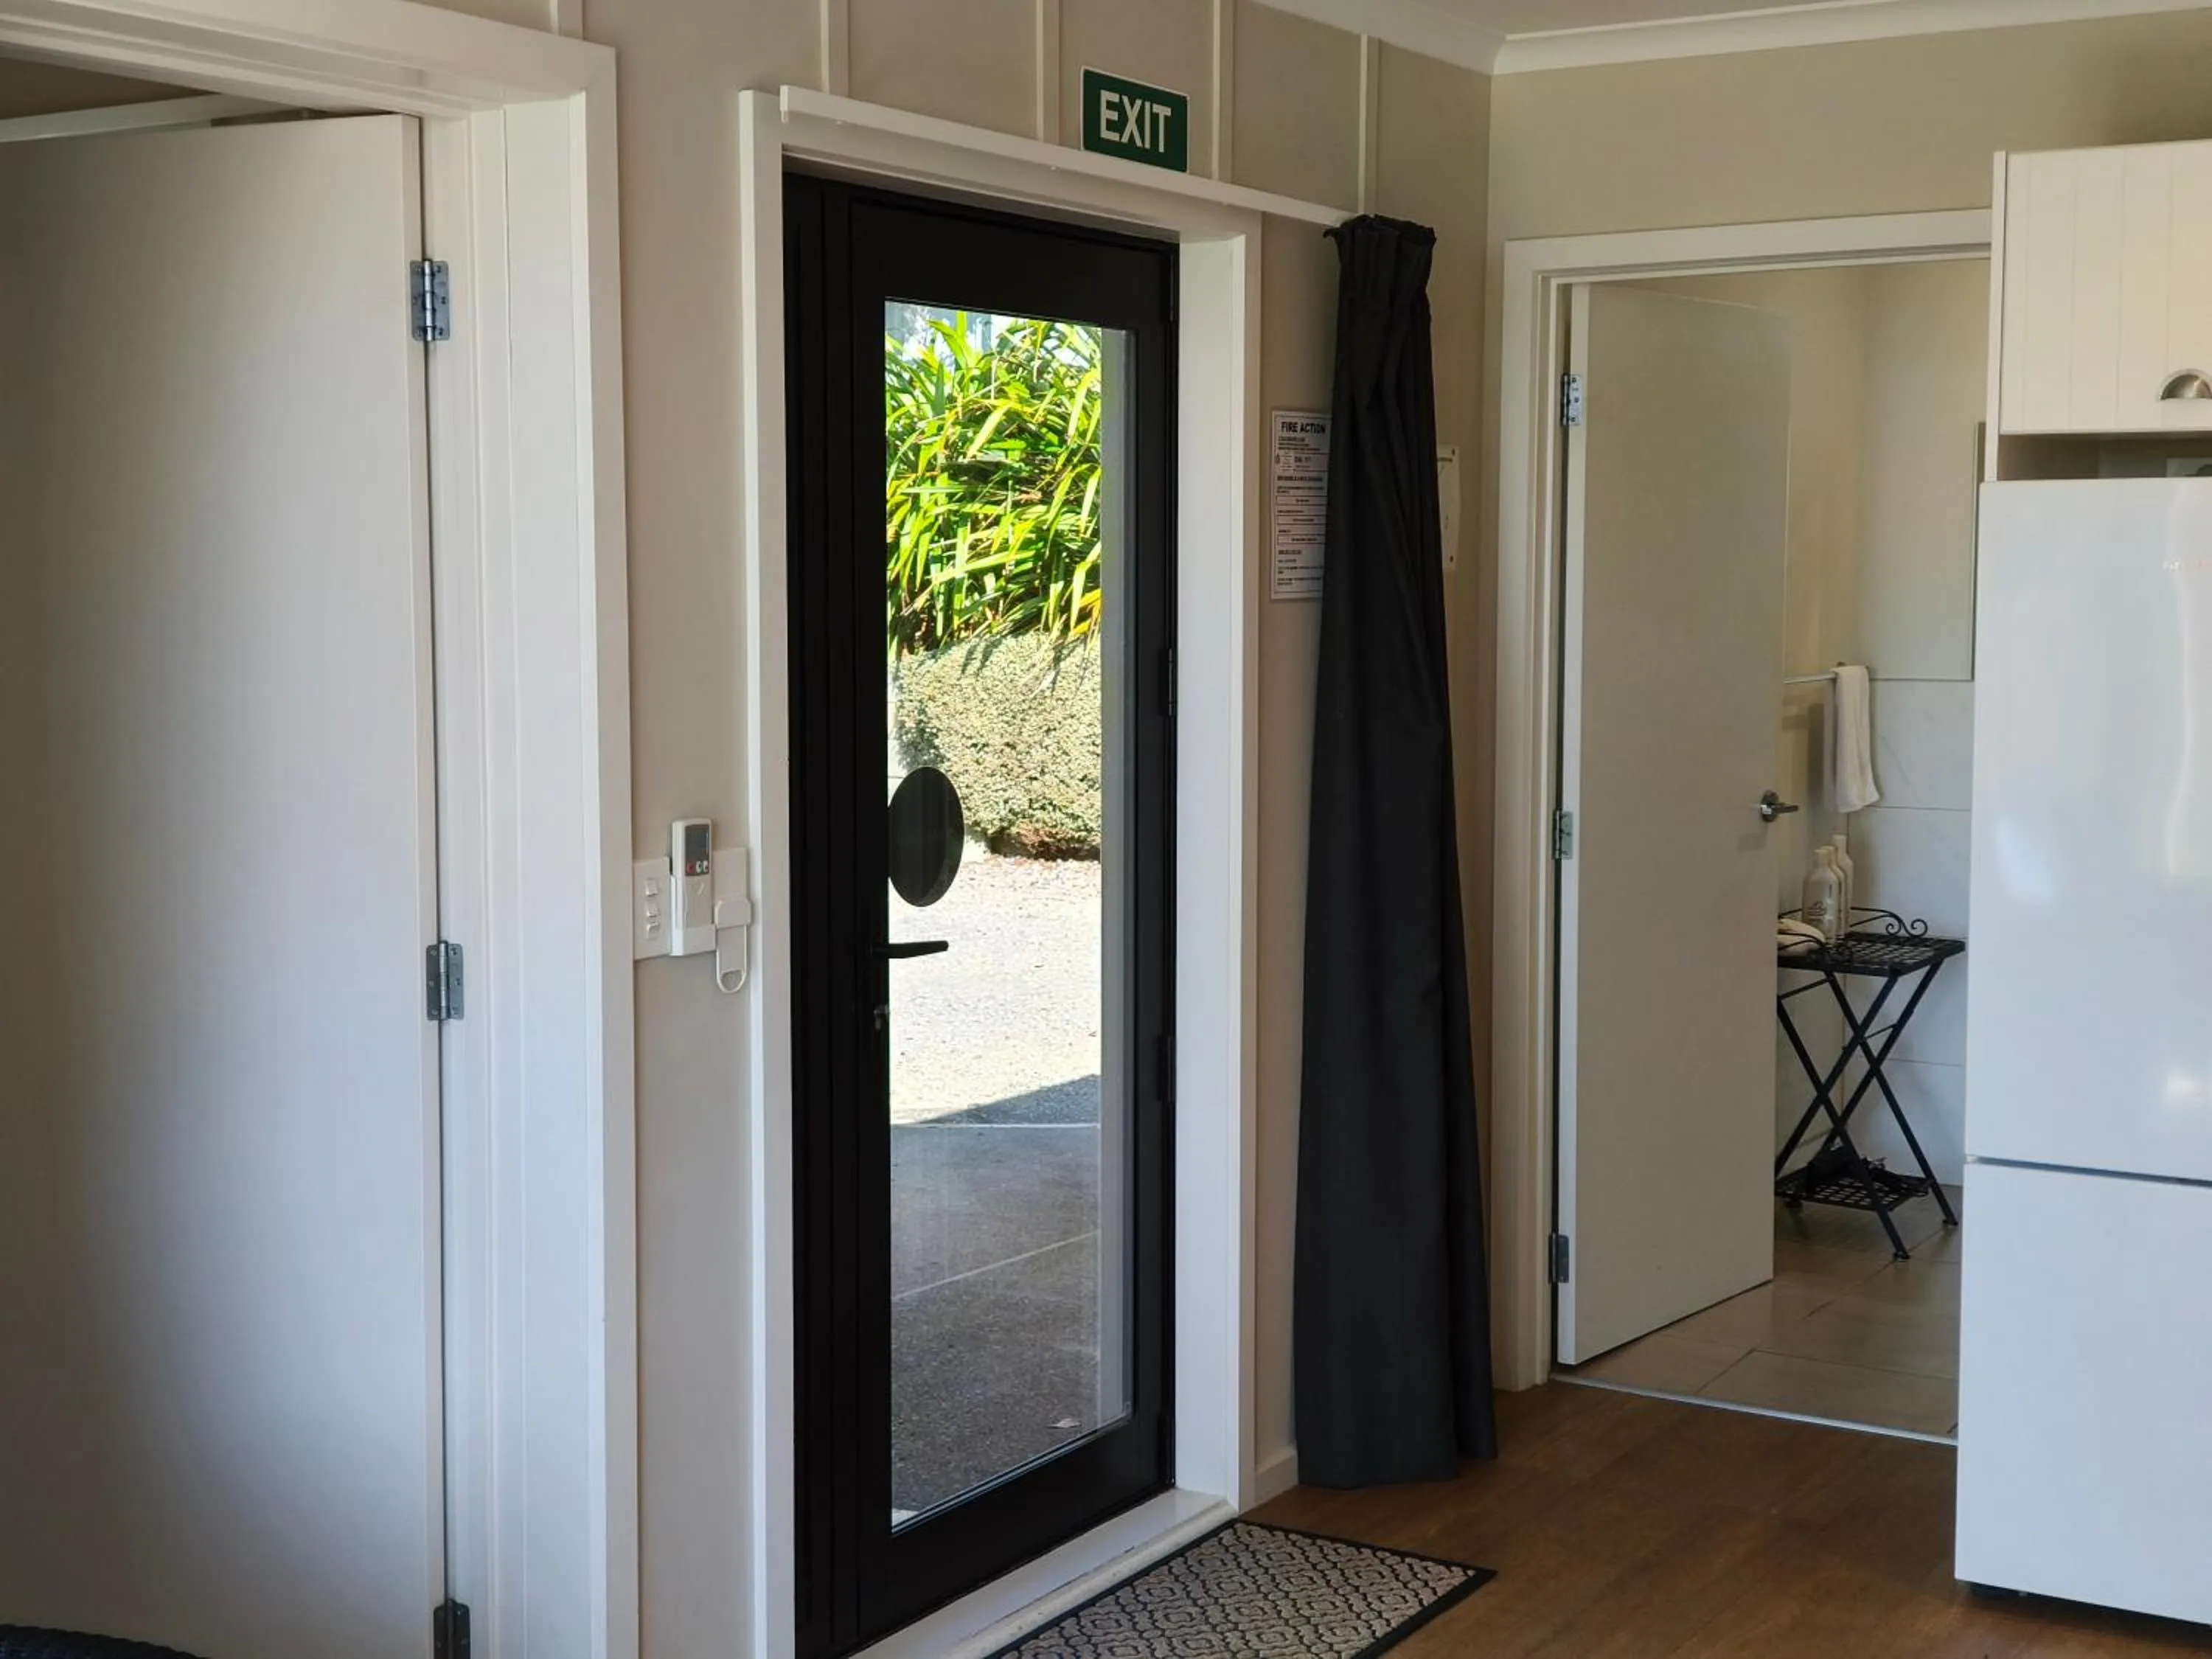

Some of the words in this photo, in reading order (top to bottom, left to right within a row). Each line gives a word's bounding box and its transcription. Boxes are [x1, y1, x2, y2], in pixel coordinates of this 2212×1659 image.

[1100, 89, 1172, 153] EXIT
[1281, 421, 1298, 433] FIRE
[1300, 422, 1326, 434] ACTION
